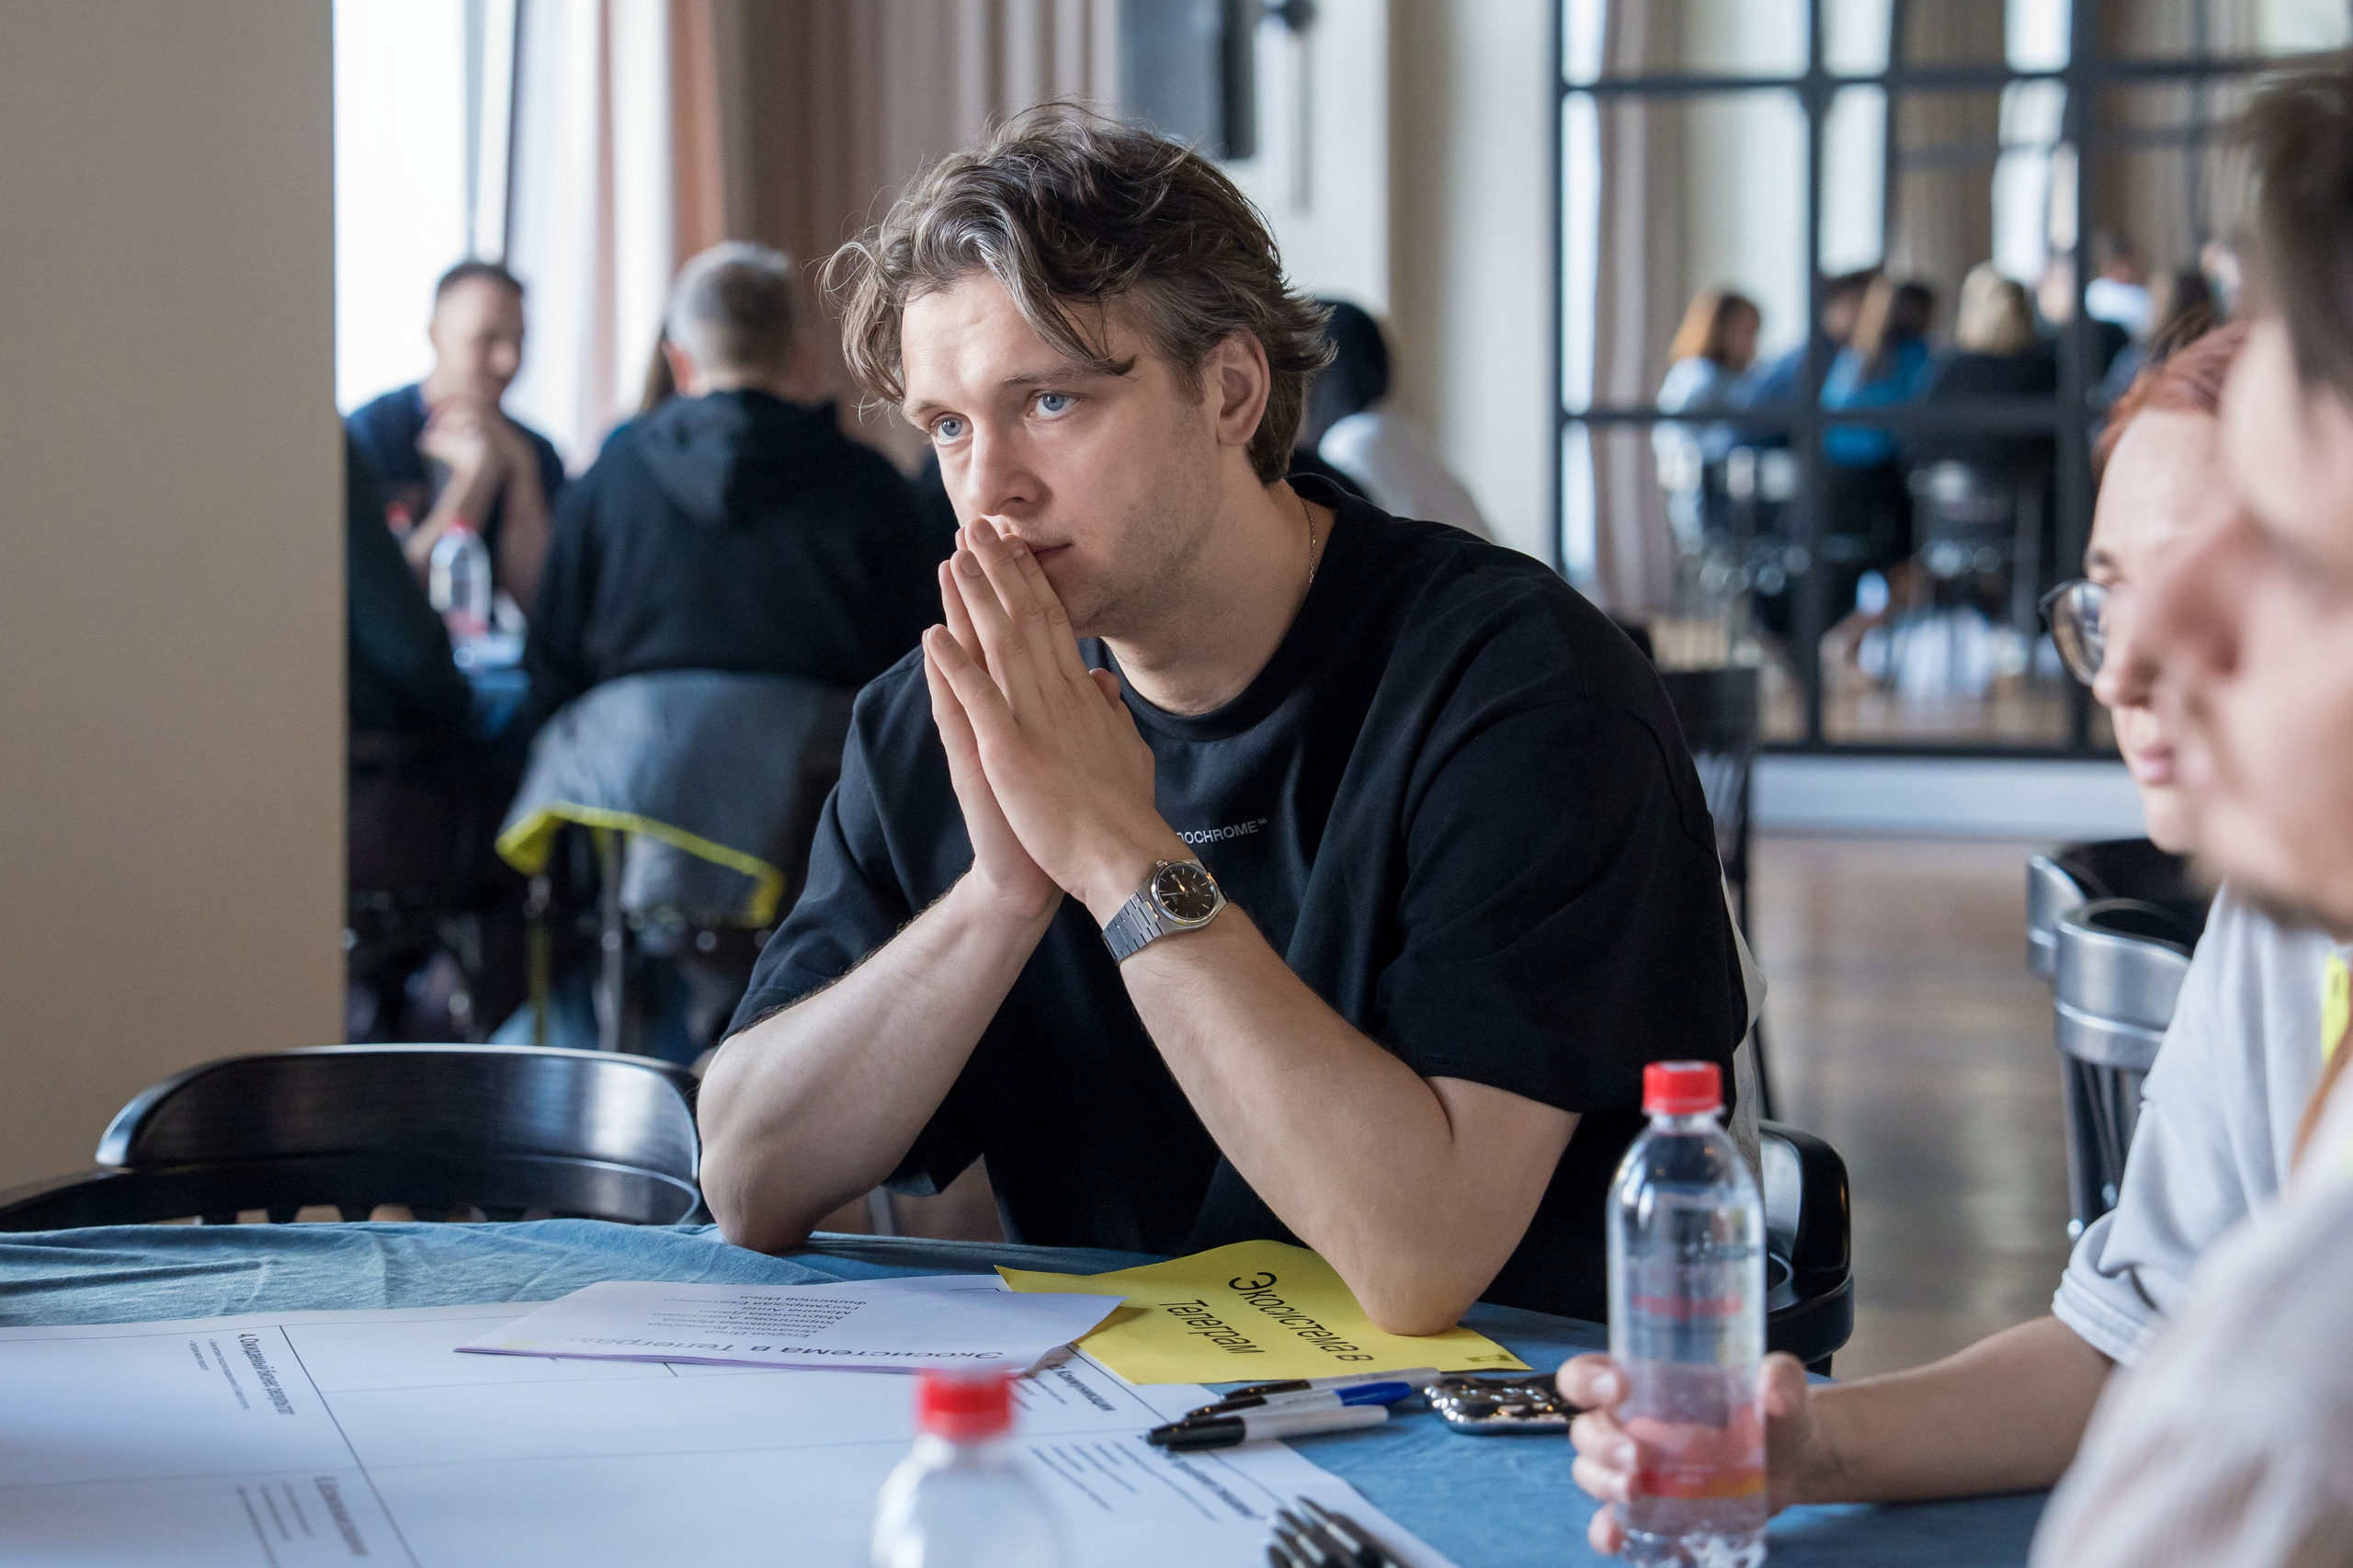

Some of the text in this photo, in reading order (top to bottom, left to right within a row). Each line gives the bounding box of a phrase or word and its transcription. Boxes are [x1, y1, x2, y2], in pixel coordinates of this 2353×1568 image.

[785, 1297, 867, 1305] Филиппов
[1229, 1271, 1359, 1352] Экосистема
[719, 1321, 827, 1329] Колесникова
[1159, 1299, 1266, 1354] Телеграм
[566, 1336, 734, 1351] Телеграм
[780, 1346, 1004, 1358] Экосистема
